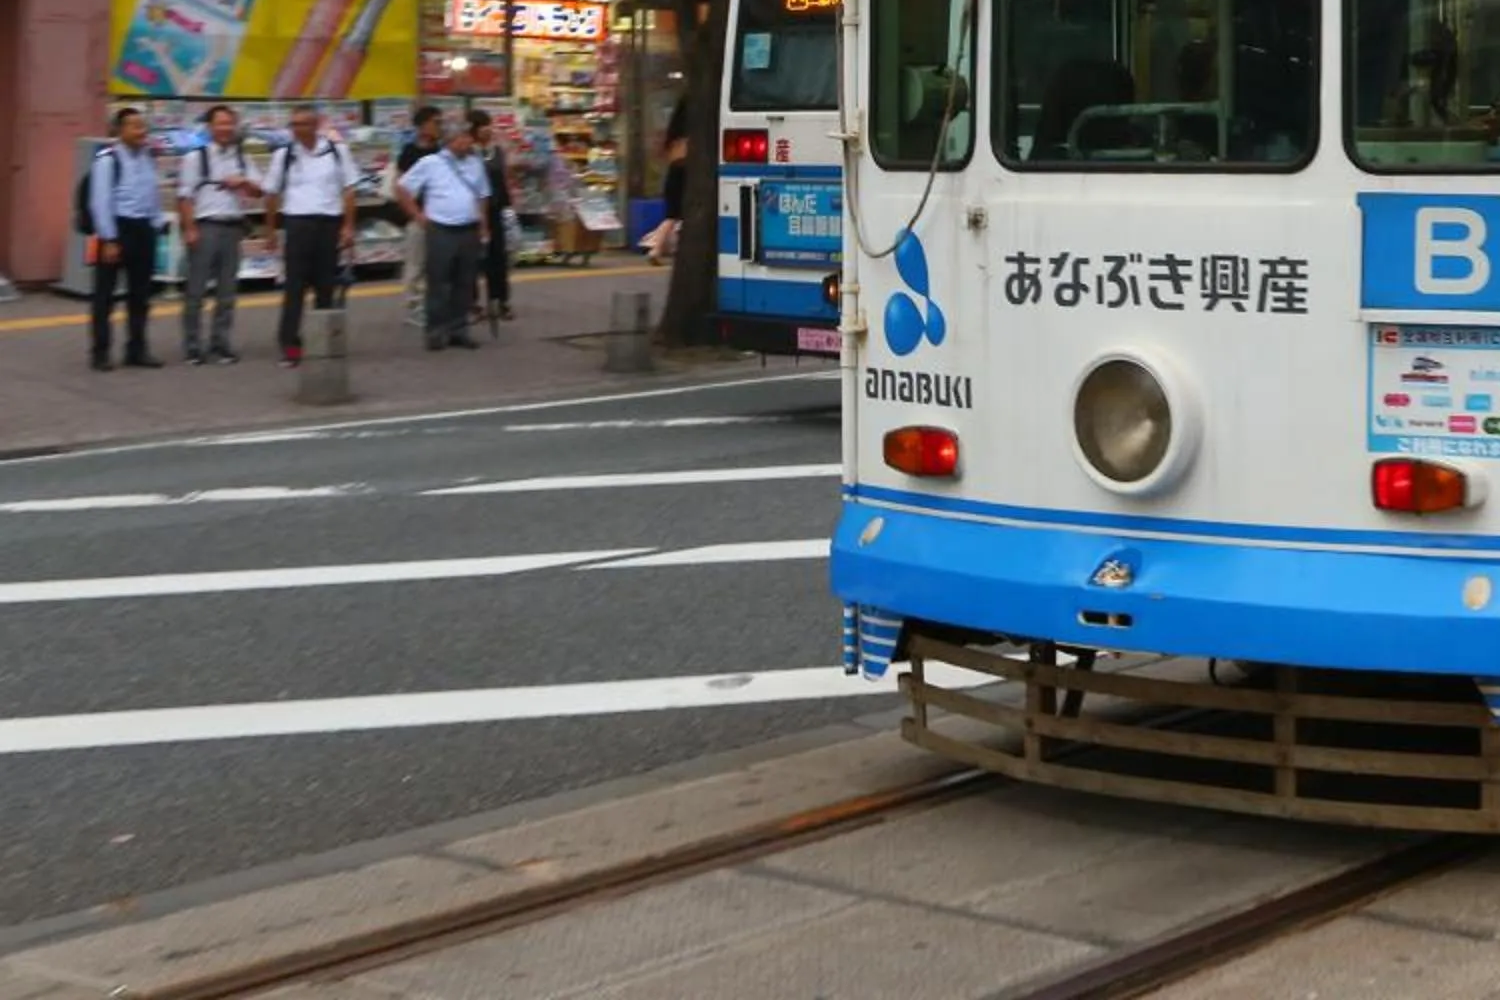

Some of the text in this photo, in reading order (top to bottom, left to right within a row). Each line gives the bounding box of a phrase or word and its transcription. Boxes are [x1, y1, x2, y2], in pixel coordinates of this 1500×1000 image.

[1004, 251, 1309, 315] あなぶき興産
[1414, 207, 1491, 294] B
